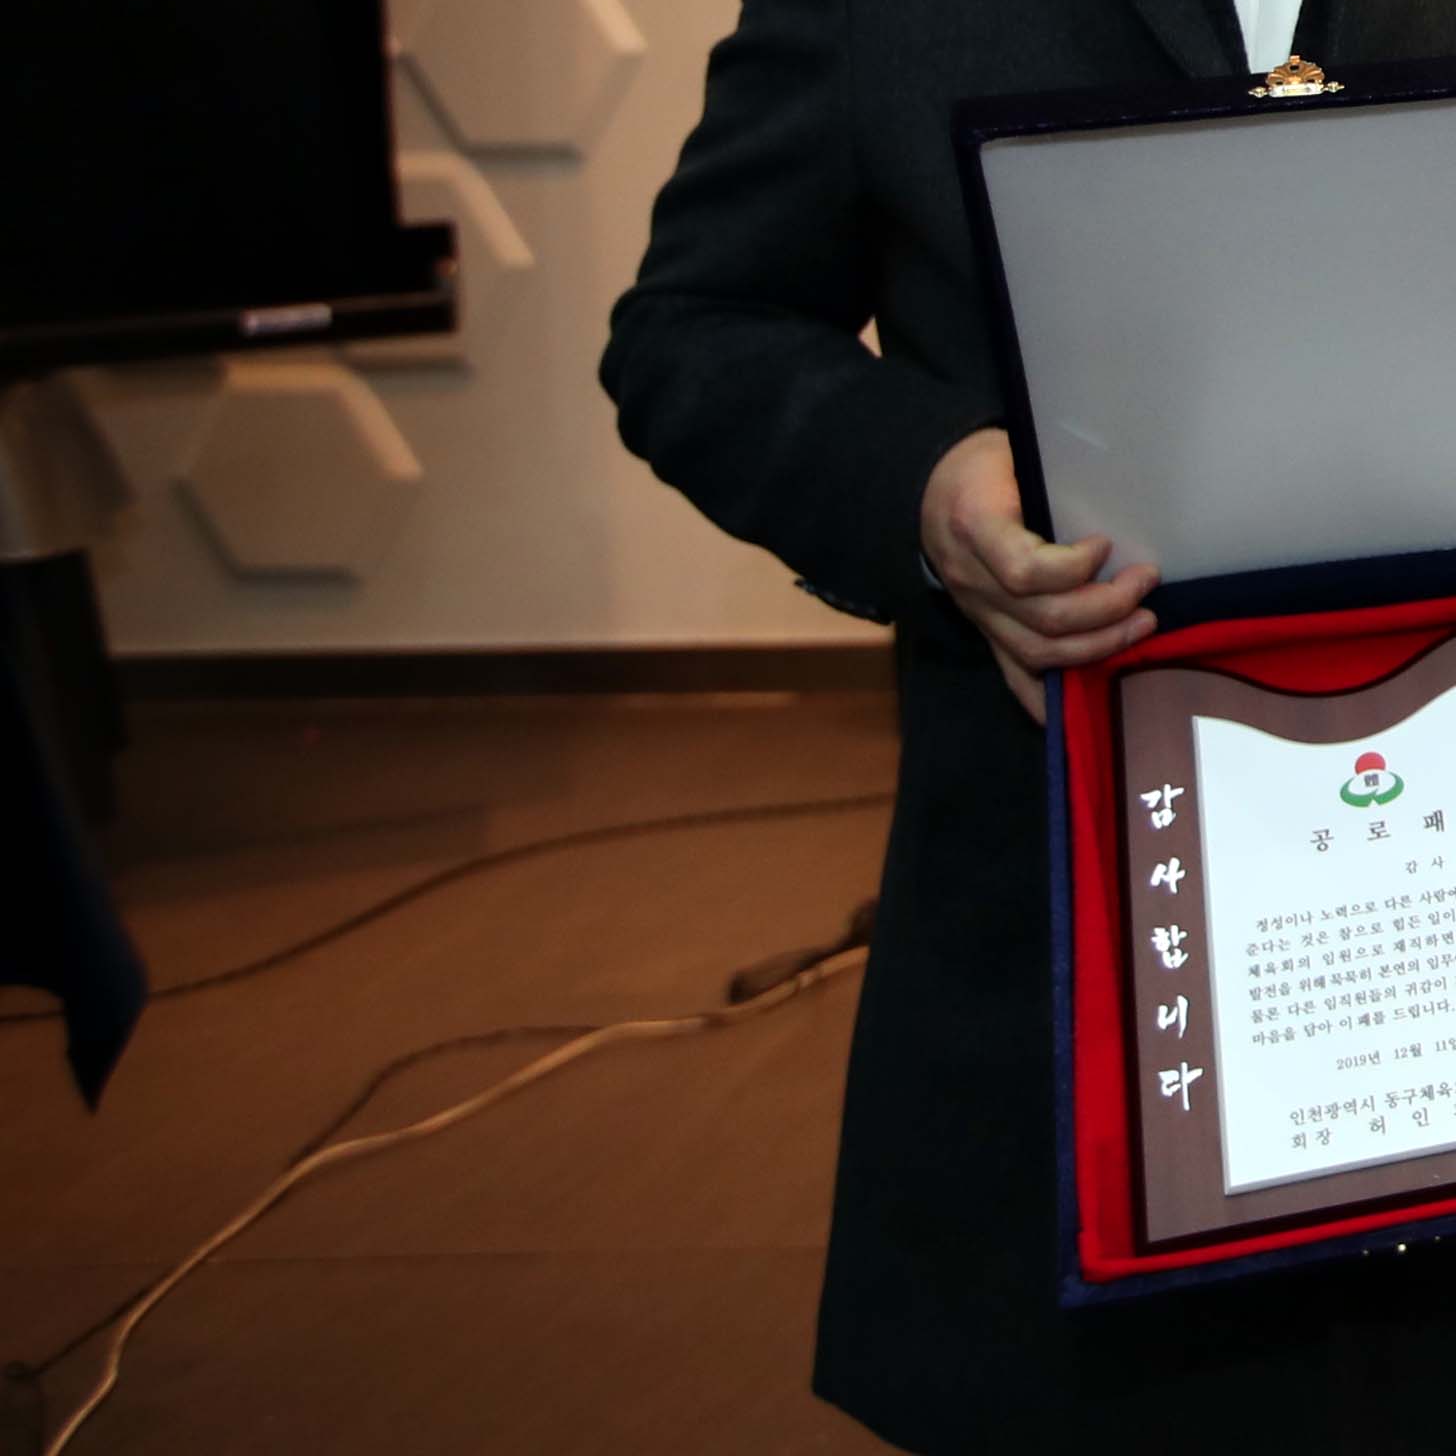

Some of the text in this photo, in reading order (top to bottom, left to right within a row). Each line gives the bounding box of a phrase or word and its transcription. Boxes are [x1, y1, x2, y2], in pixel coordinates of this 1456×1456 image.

[1310, 809, 1445, 852] 공로패
[1320, 901, 1378, 920] 노력으로
[1384, 895, 1412, 910] 다른
[1140, 784, 1203, 1111] 감사합니다
[1301, 930, 1329, 948] 것은
[1339, 922, 1384, 941] 참으로
[1393, 915, 1421, 932] 힘든
[1248, 955, 1311, 978] 체육회의
[1322, 944, 1385, 966] 임원으로
[1249, 982, 1290, 1001] 발전을
[1299, 975, 1326, 992] 위해
[1378, 958, 1420, 978] 본연의
[1252, 1027, 1296, 1047] 마음을
[1304, 1019, 1333, 1038] 담아
[1339, 1016, 1353, 1030] 이
[1392, 998, 1456, 1020] 드립니다.
[1288, 1000, 1317, 1016] 다른
[1336, 1050, 1381, 1070] 2019년
[1394, 1042, 1423, 1060] 12월
[1290, 1094, 1376, 1126] 인천광역시
[1291, 1127, 1331, 1149] 회장
